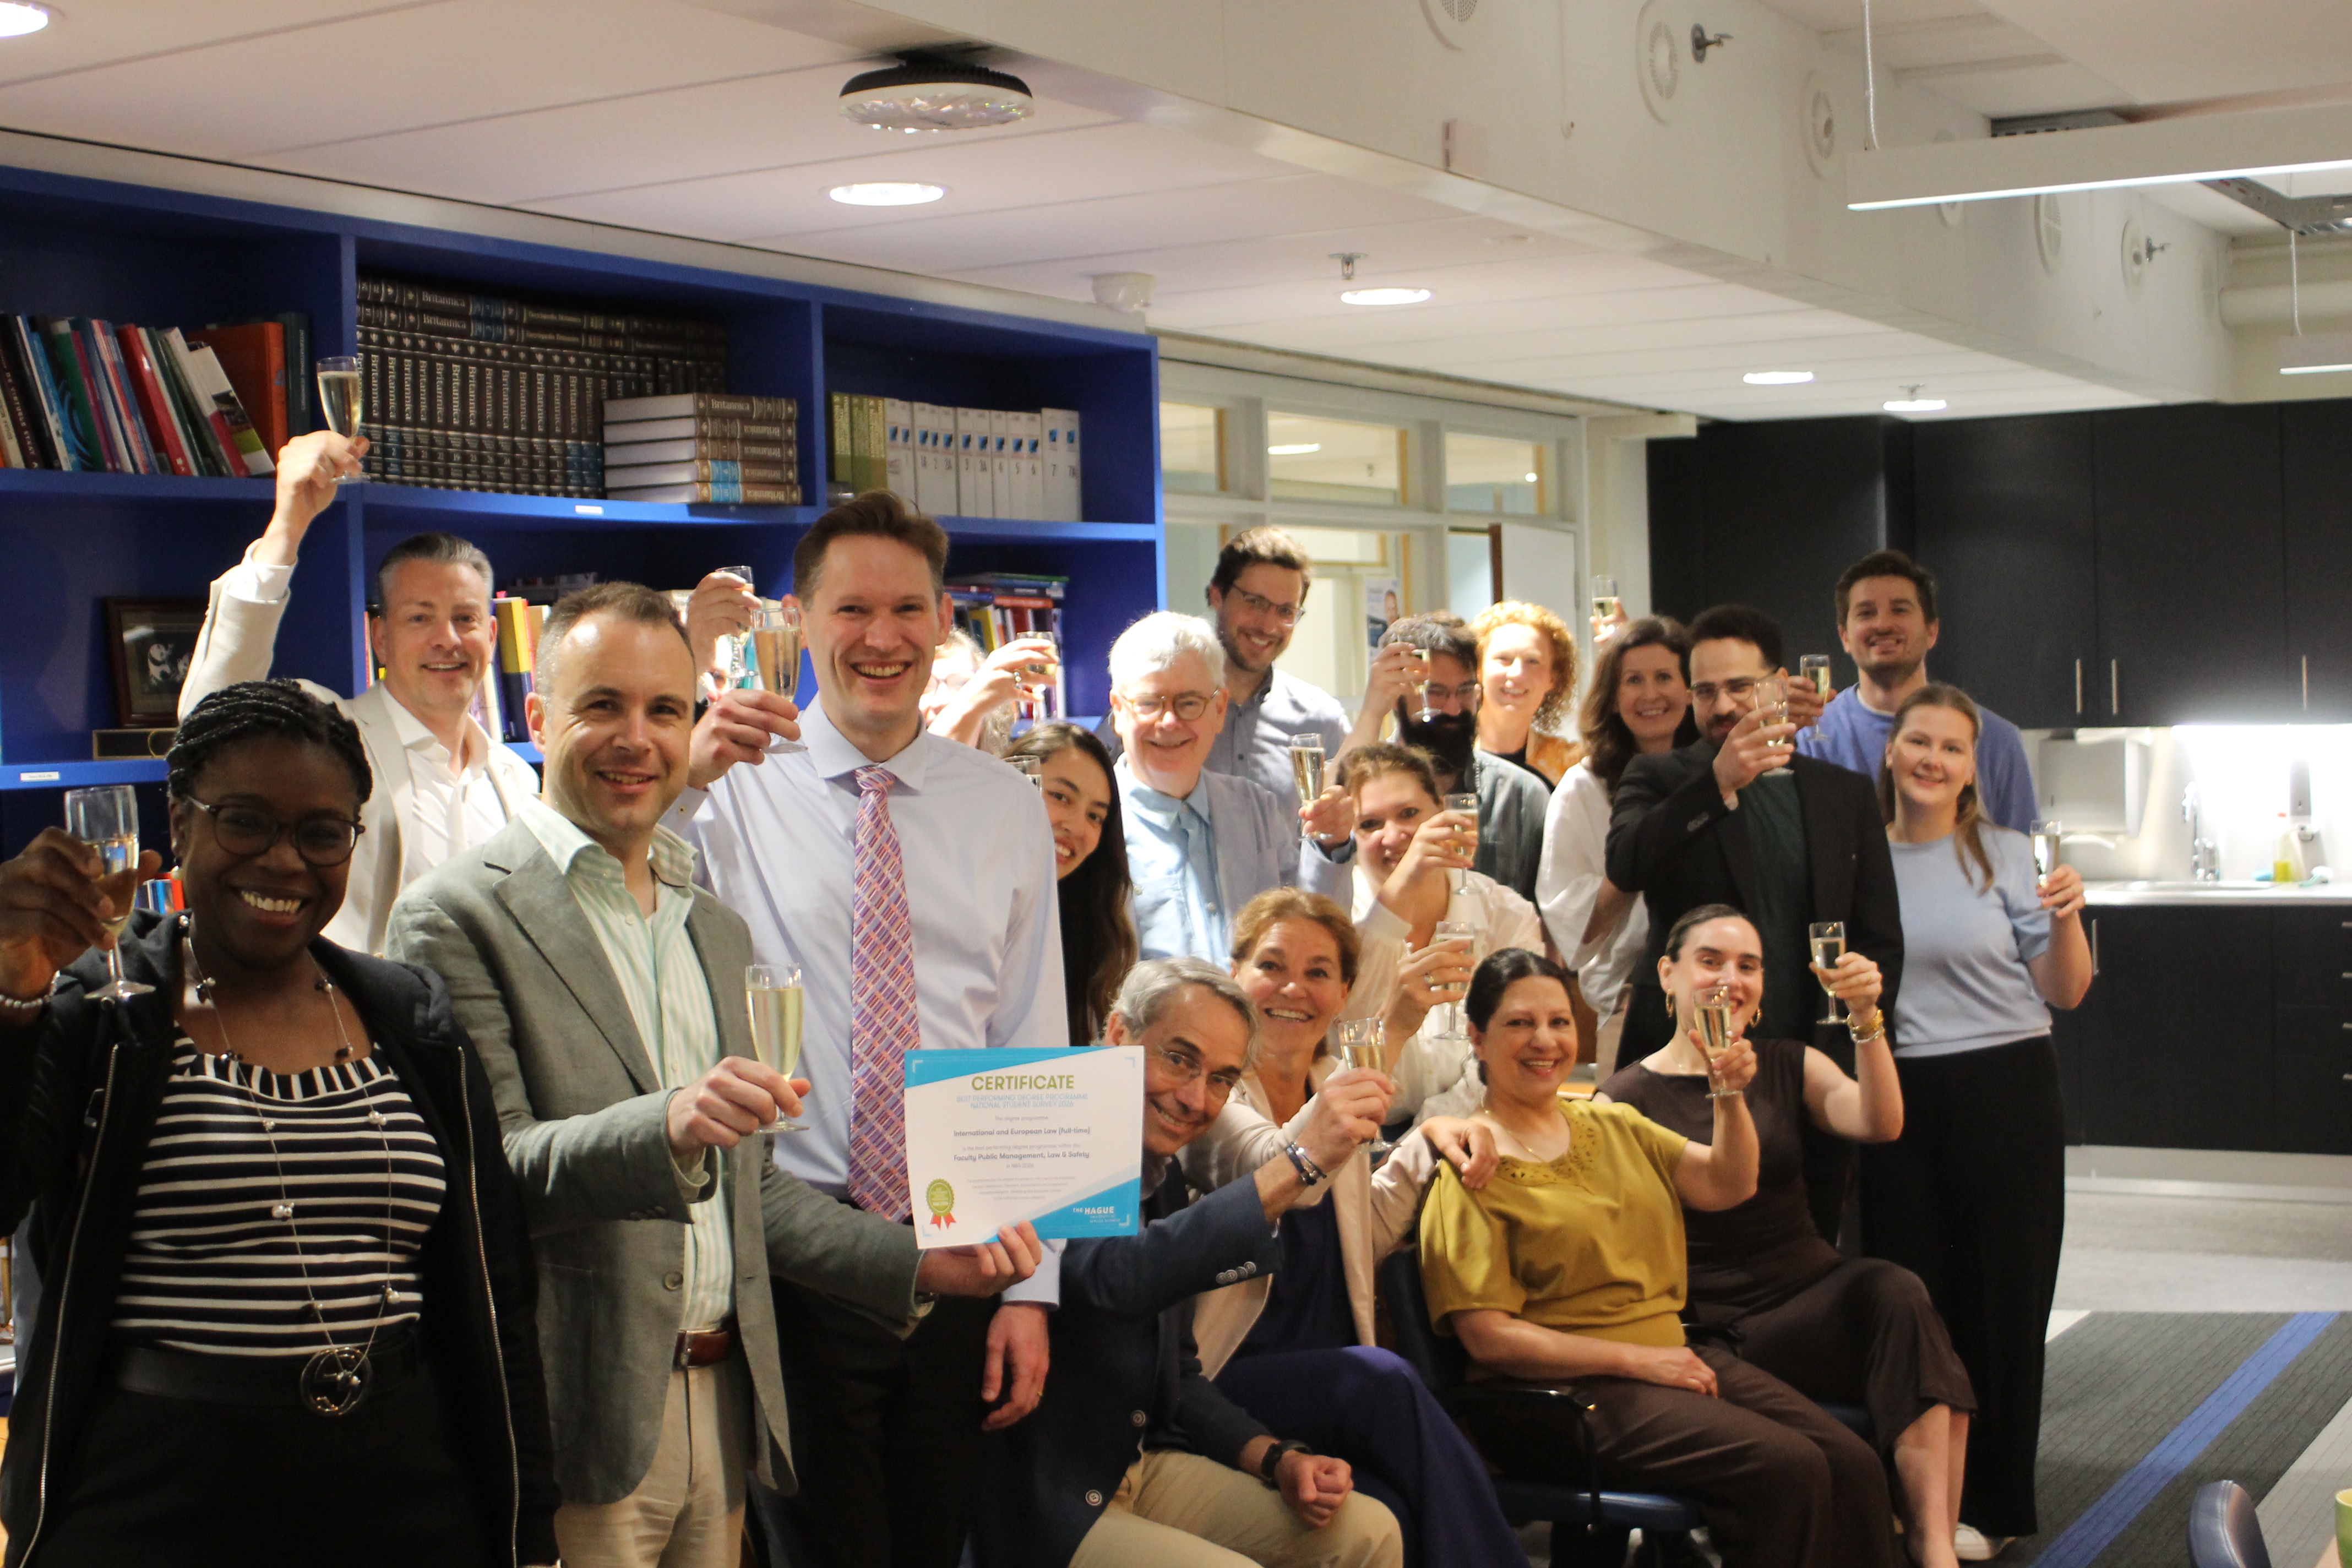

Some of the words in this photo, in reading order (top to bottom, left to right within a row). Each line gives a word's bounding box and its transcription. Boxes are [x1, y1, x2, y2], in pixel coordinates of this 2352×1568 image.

[422, 290, 465, 307] Britannica
[423, 313, 466, 329] Britannica
[371, 354, 379, 418] Britannica
[388, 356, 397, 420] Britannica
[404, 358, 413, 421] Britannica
[419, 360, 428, 422] Britannica
[435, 362, 444, 423] Britannica
[452, 363, 461, 425] Britannica
[468, 366, 477, 426] Britannica
[485, 368, 493, 428] Britannica
[502, 369, 510, 429] Britannica
[519, 372, 527, 431] Britannica
[536, 373, 545, 432] Britannica
[553, 374, 562, 433] Britannica
[569, 375, 578, 433] Britannica
[711, 398, 750, 411] Britannica
[391, 448, 396, 456] 2
[744, 424, 780, 437] Britannica
[746, 489, 785, 501] Britannica
[1052, 464, 1057, 477] 7
[971, 1075, 1075, 1091] CERTIFICATE
[972, 1094, 1015, 1102] PERFORMING
[999, 1152, 1046, 1161] Management,
[1068, 1151, 1090, 1159] Safety
[1010, 1128, 1042, 1136] European
[1058, 1126, 1090, 1135] (full-time)
[1084, 1206, 1115, 1215] HAGUE
